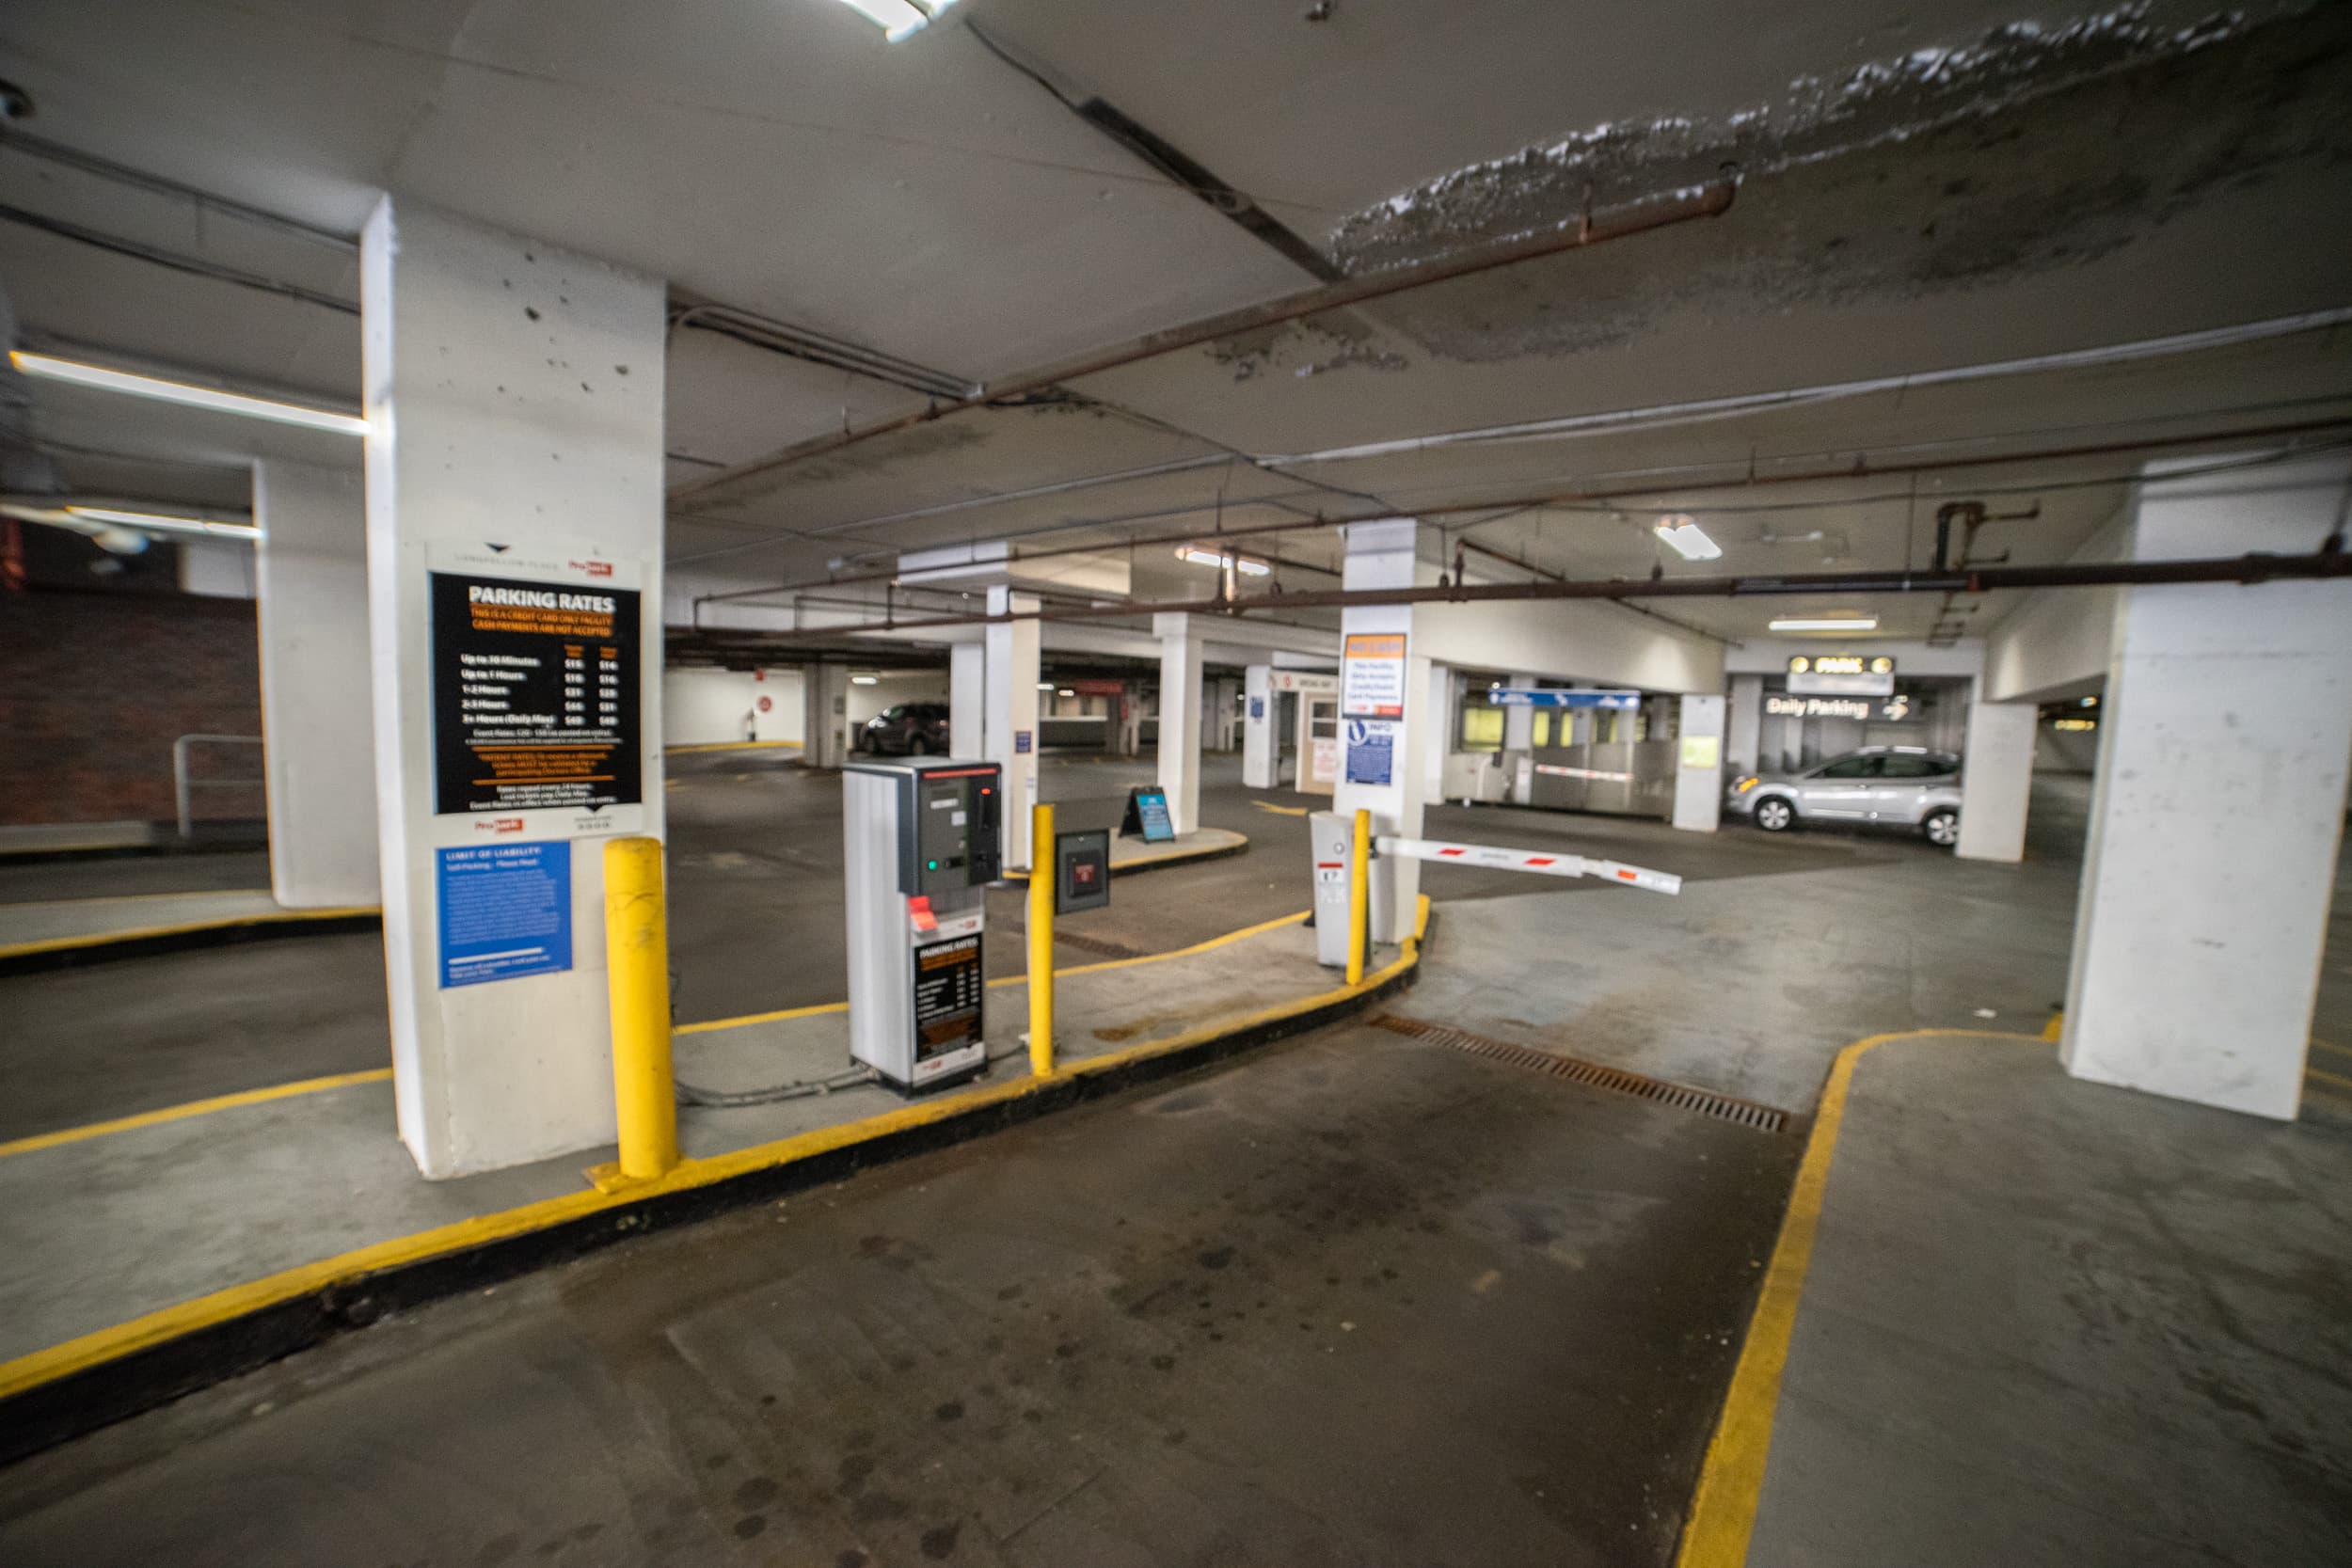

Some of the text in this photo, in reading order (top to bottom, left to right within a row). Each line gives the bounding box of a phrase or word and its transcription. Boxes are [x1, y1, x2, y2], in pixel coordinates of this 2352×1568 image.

[469, 585, 617, 612] PARKING RATES
[460, 654, 476, 666] Up
[460, 669, 476, 681] Up
[1766, 698, 1868, 720] Daily Parking
[447, 849, 475, 861] LIMIT
